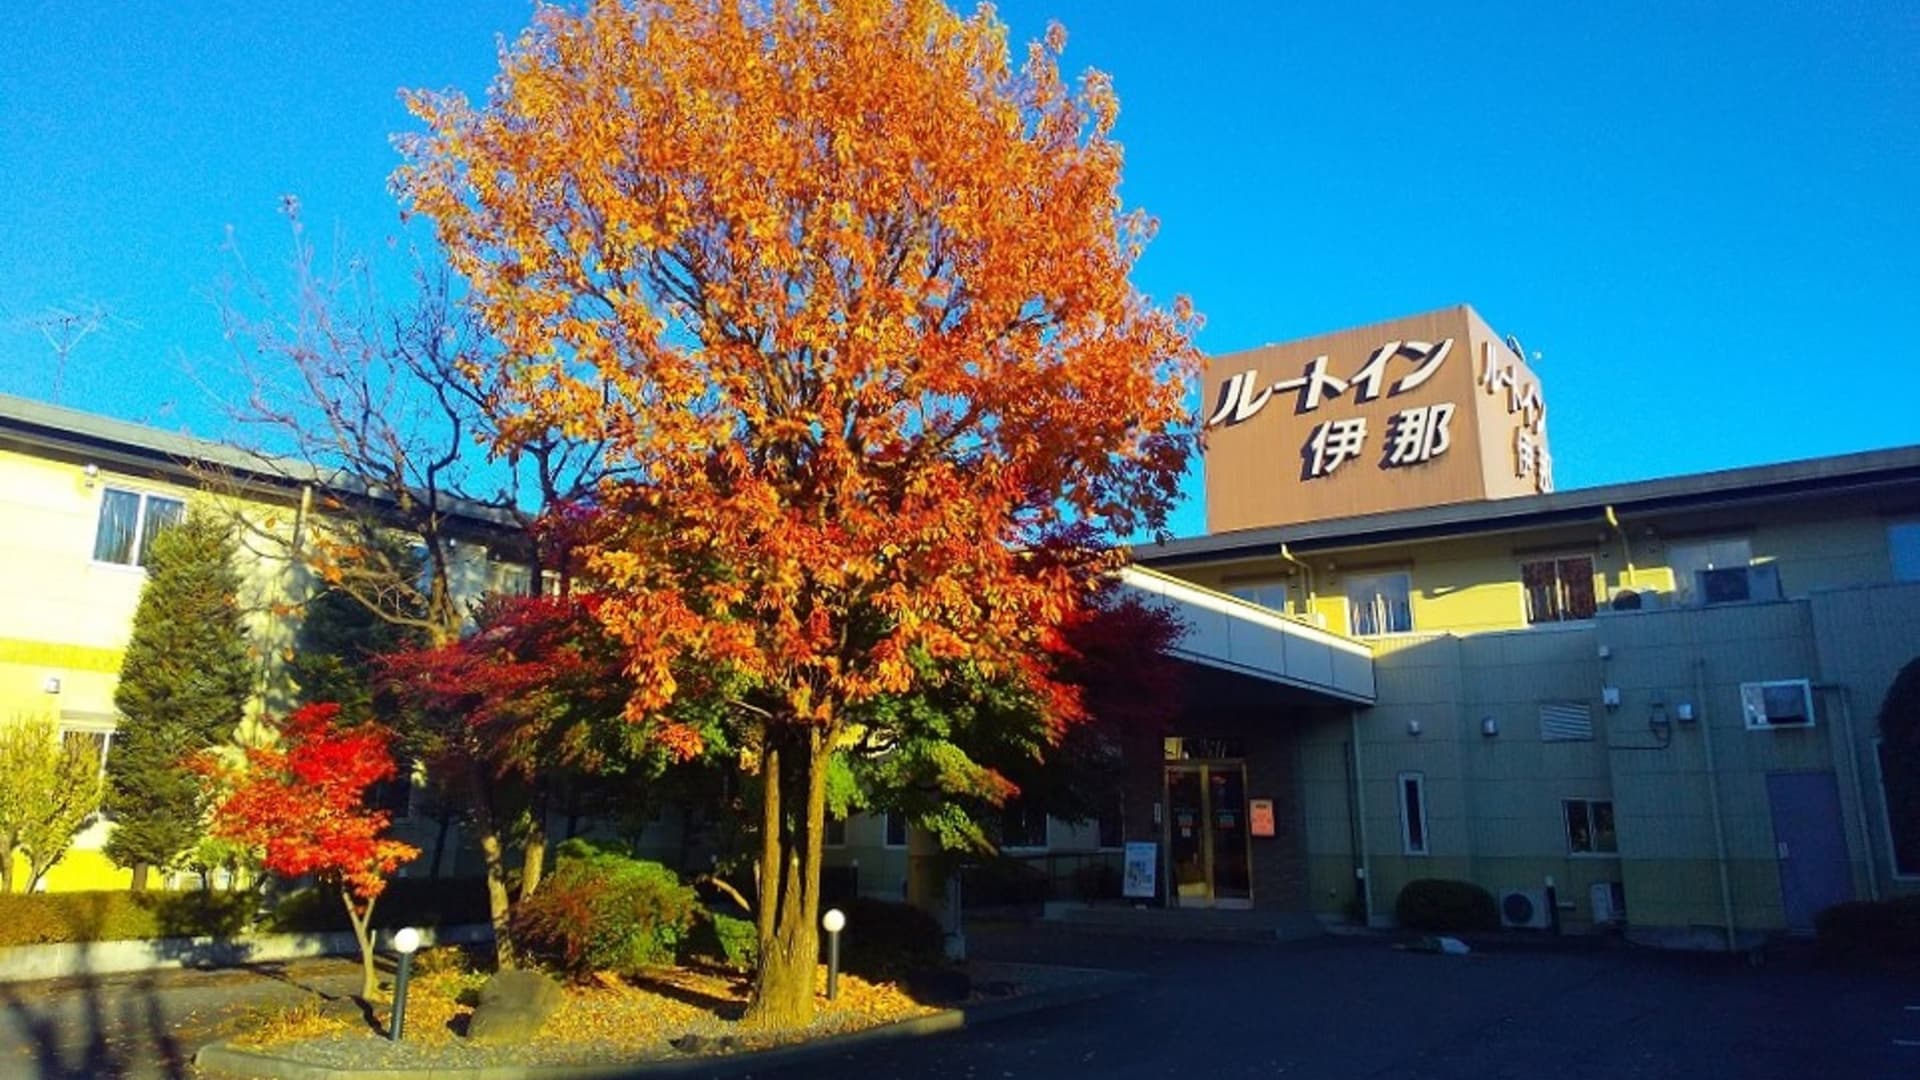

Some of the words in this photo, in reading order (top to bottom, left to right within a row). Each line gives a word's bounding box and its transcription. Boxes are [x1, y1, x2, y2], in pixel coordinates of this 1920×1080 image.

[1208, 338, 1454, 427] ルートイン
[1304, 402, 1456, 479] 伊那
